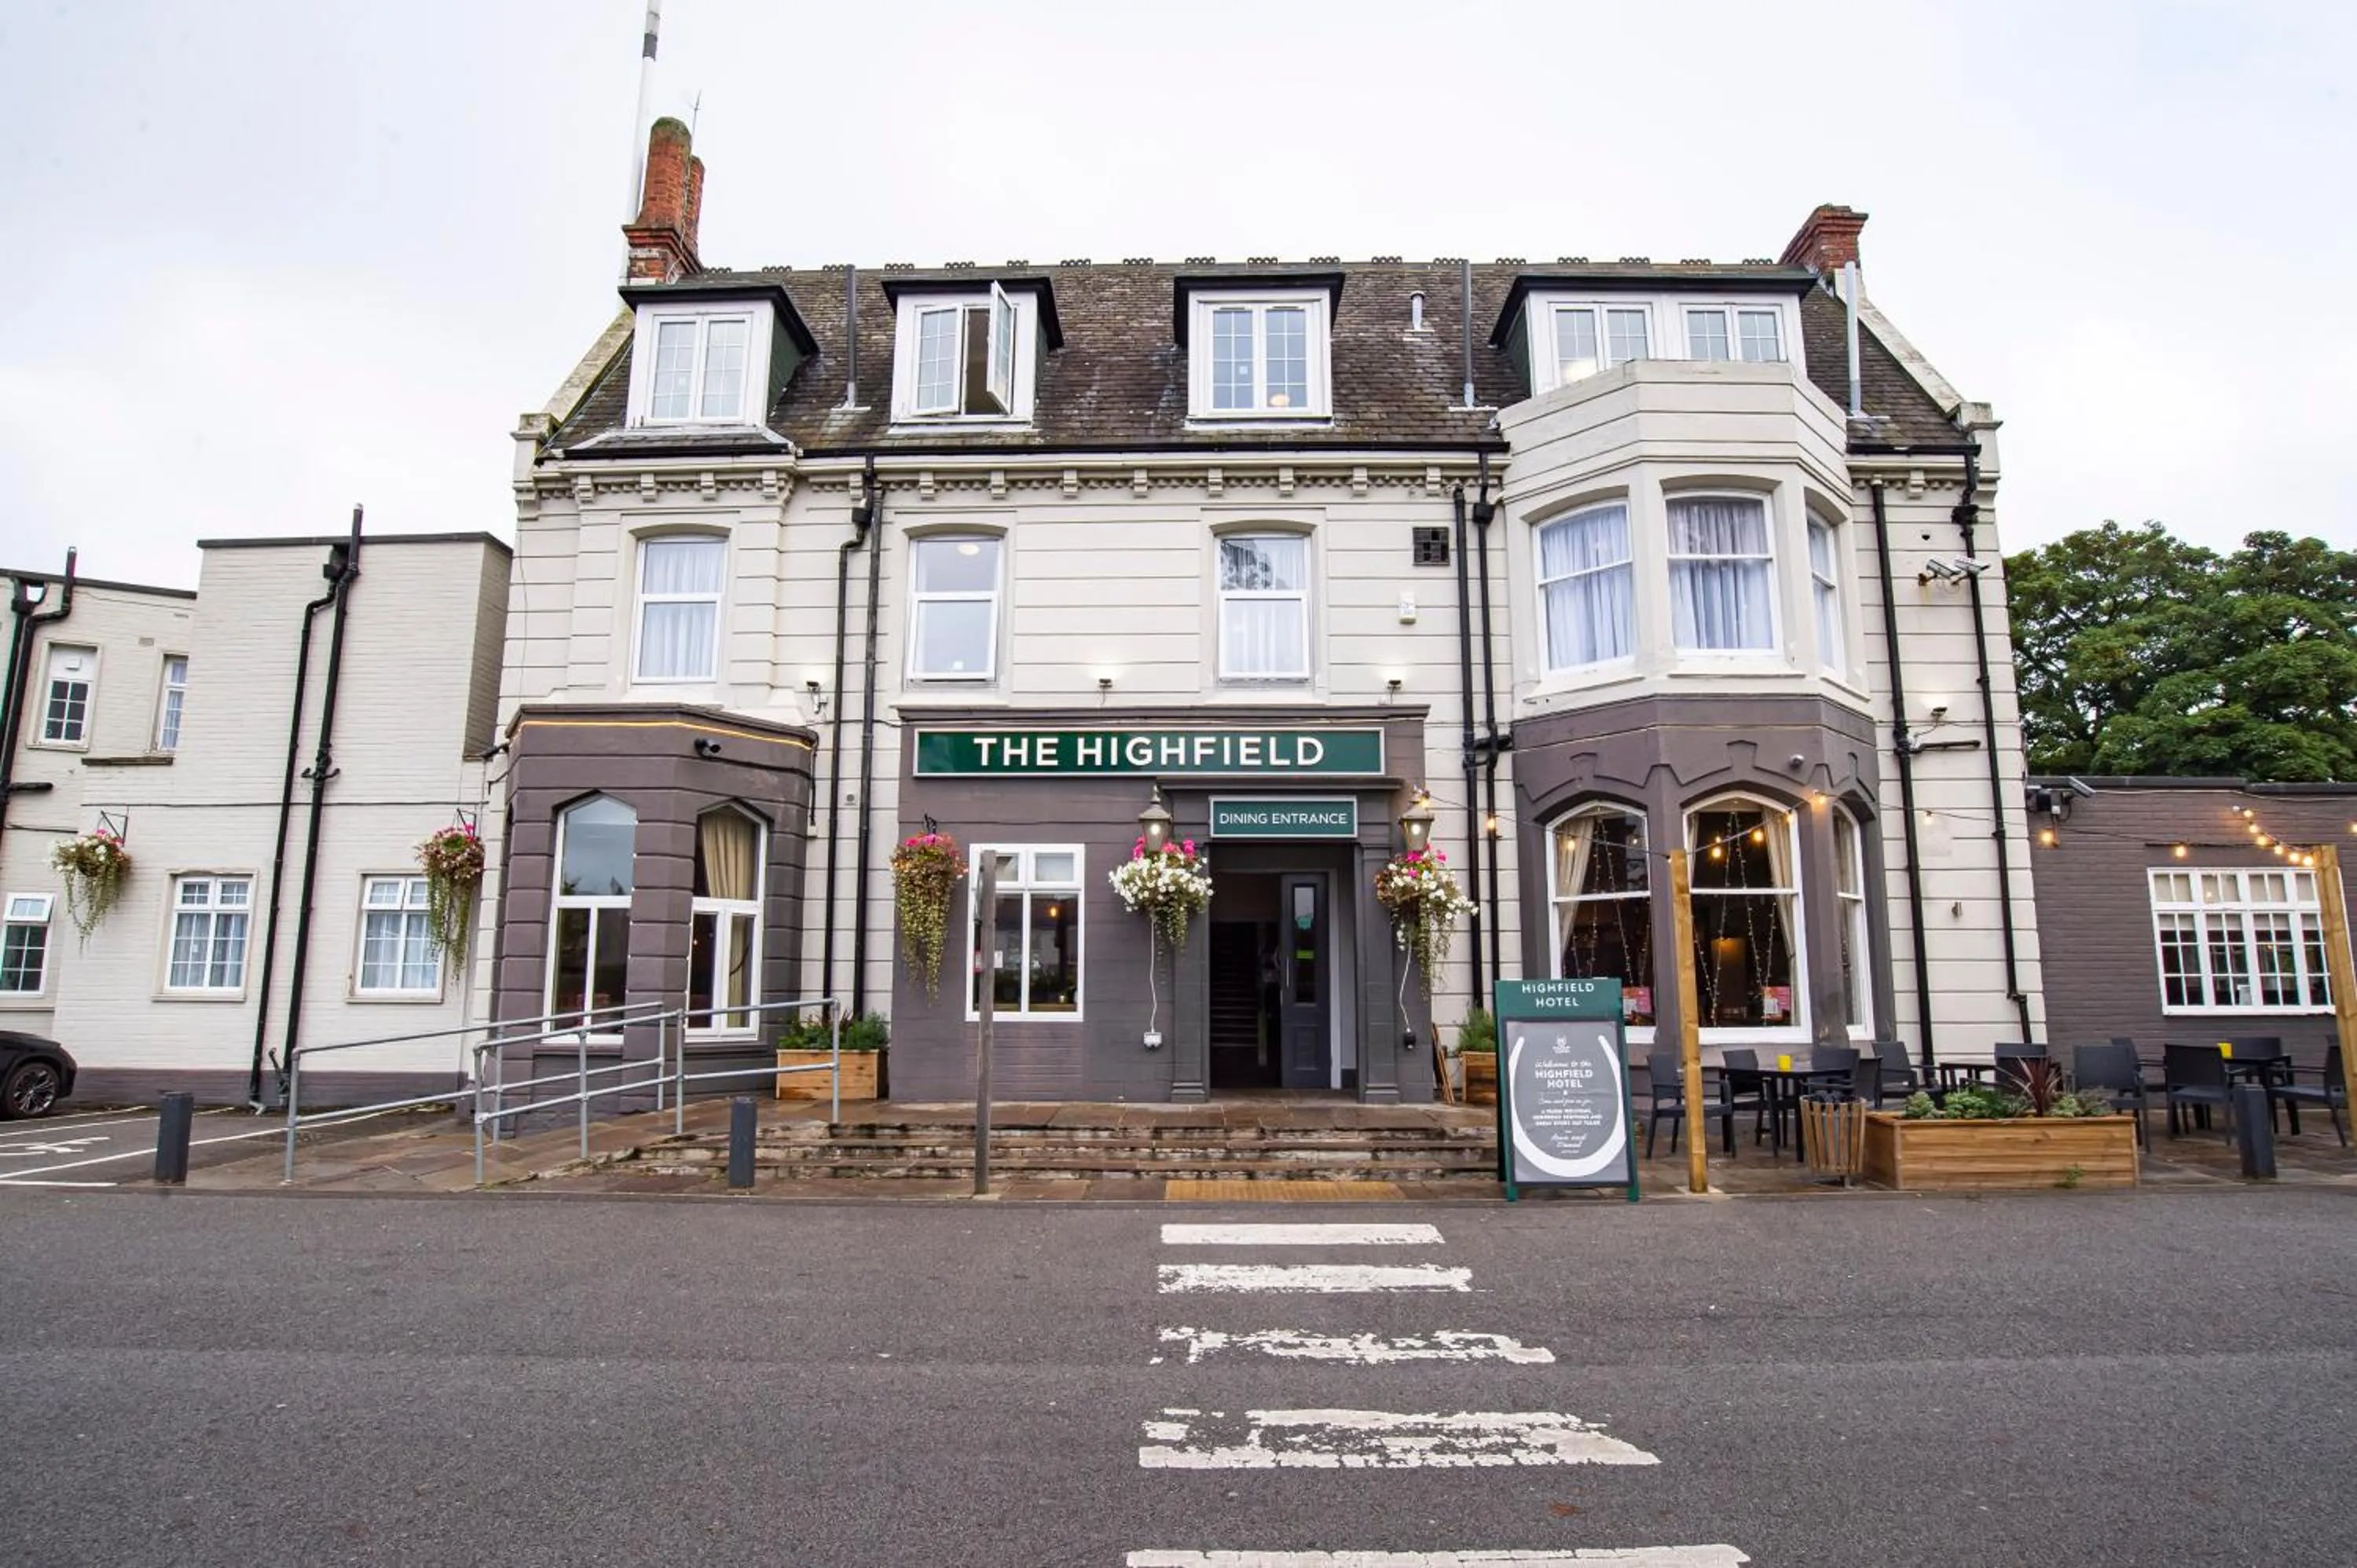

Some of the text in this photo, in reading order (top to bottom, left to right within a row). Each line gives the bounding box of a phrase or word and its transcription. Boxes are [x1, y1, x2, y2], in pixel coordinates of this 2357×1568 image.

[973, 736, 1324, 766] THE HIGHFIELD
[1219, 812, 1347, 825] DINING ENTRANCE
[1522, 982, 1594, 994] HIGHFIELD
[1536, 996, 1579, 1007] HOTEL
[1534, 1069, 1593, 1079] HIGHFIELD
[1547, 1079, 1583, 1088] HOTEL
